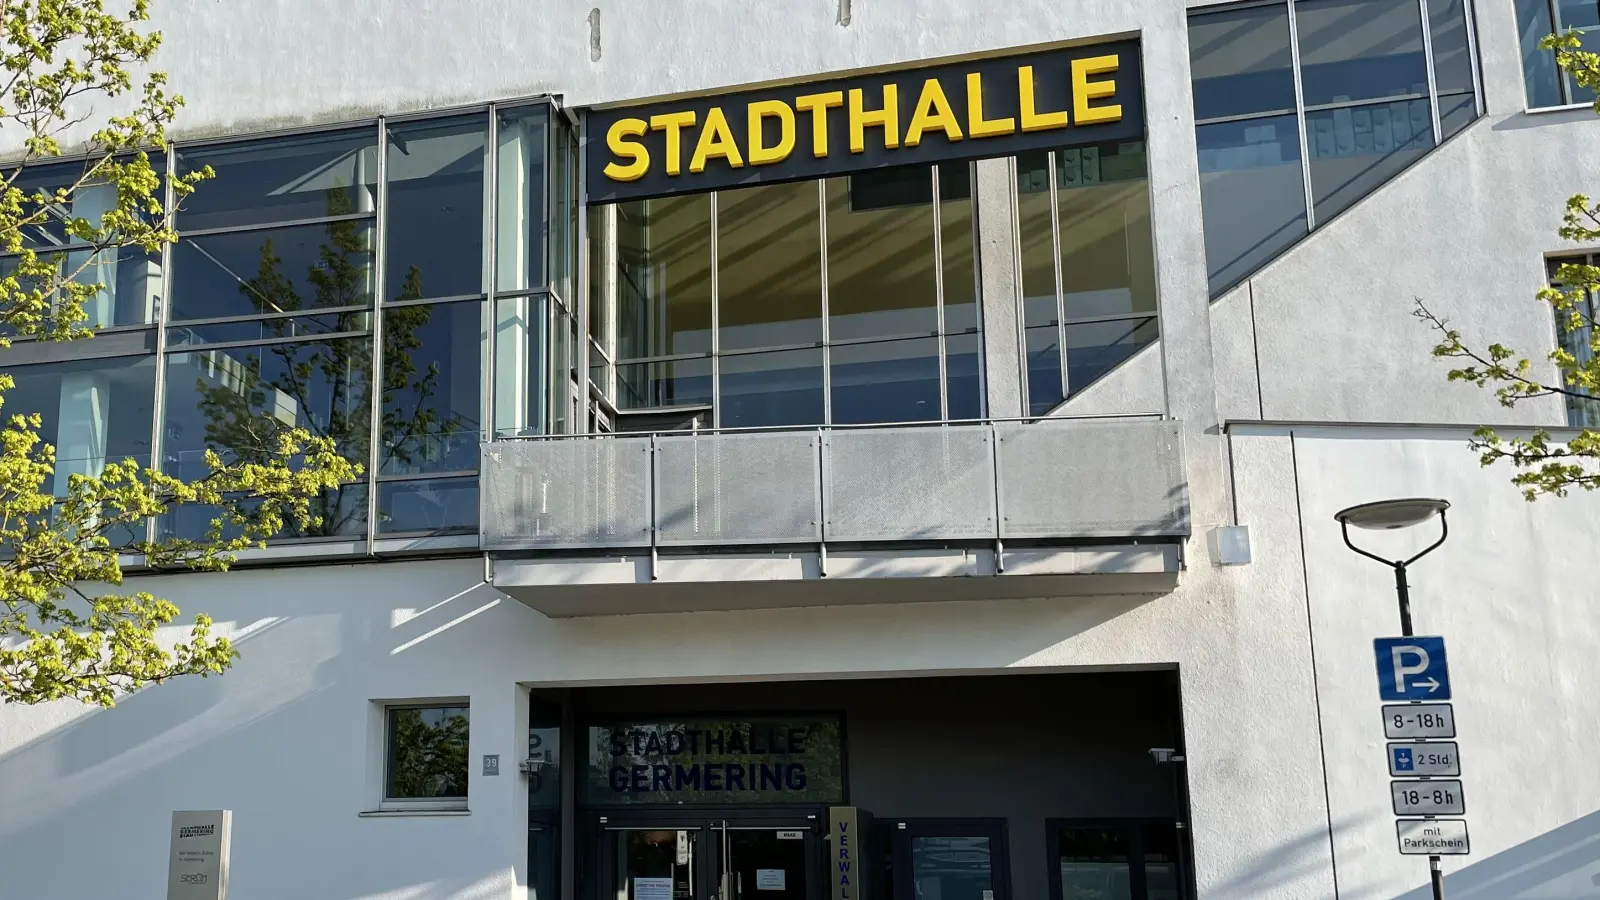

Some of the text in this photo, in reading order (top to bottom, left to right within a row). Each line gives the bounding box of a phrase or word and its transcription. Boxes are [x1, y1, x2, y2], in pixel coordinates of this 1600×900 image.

[603, 54, 1123, 182] STADTHALLE
[1391, 645, 1430, 693] P
[609, 728, 806, 757] STADTHALLE
[486, 758, 497, 768] 39
[1417, 754, 1425, 765] 2
[609, 762, 807, 793] GERMERING
[1403, 837, 1464, 849] Parkschein
[1423, 827, 1442, 836] mit
[838, 822, 850, 899] VERWAL
